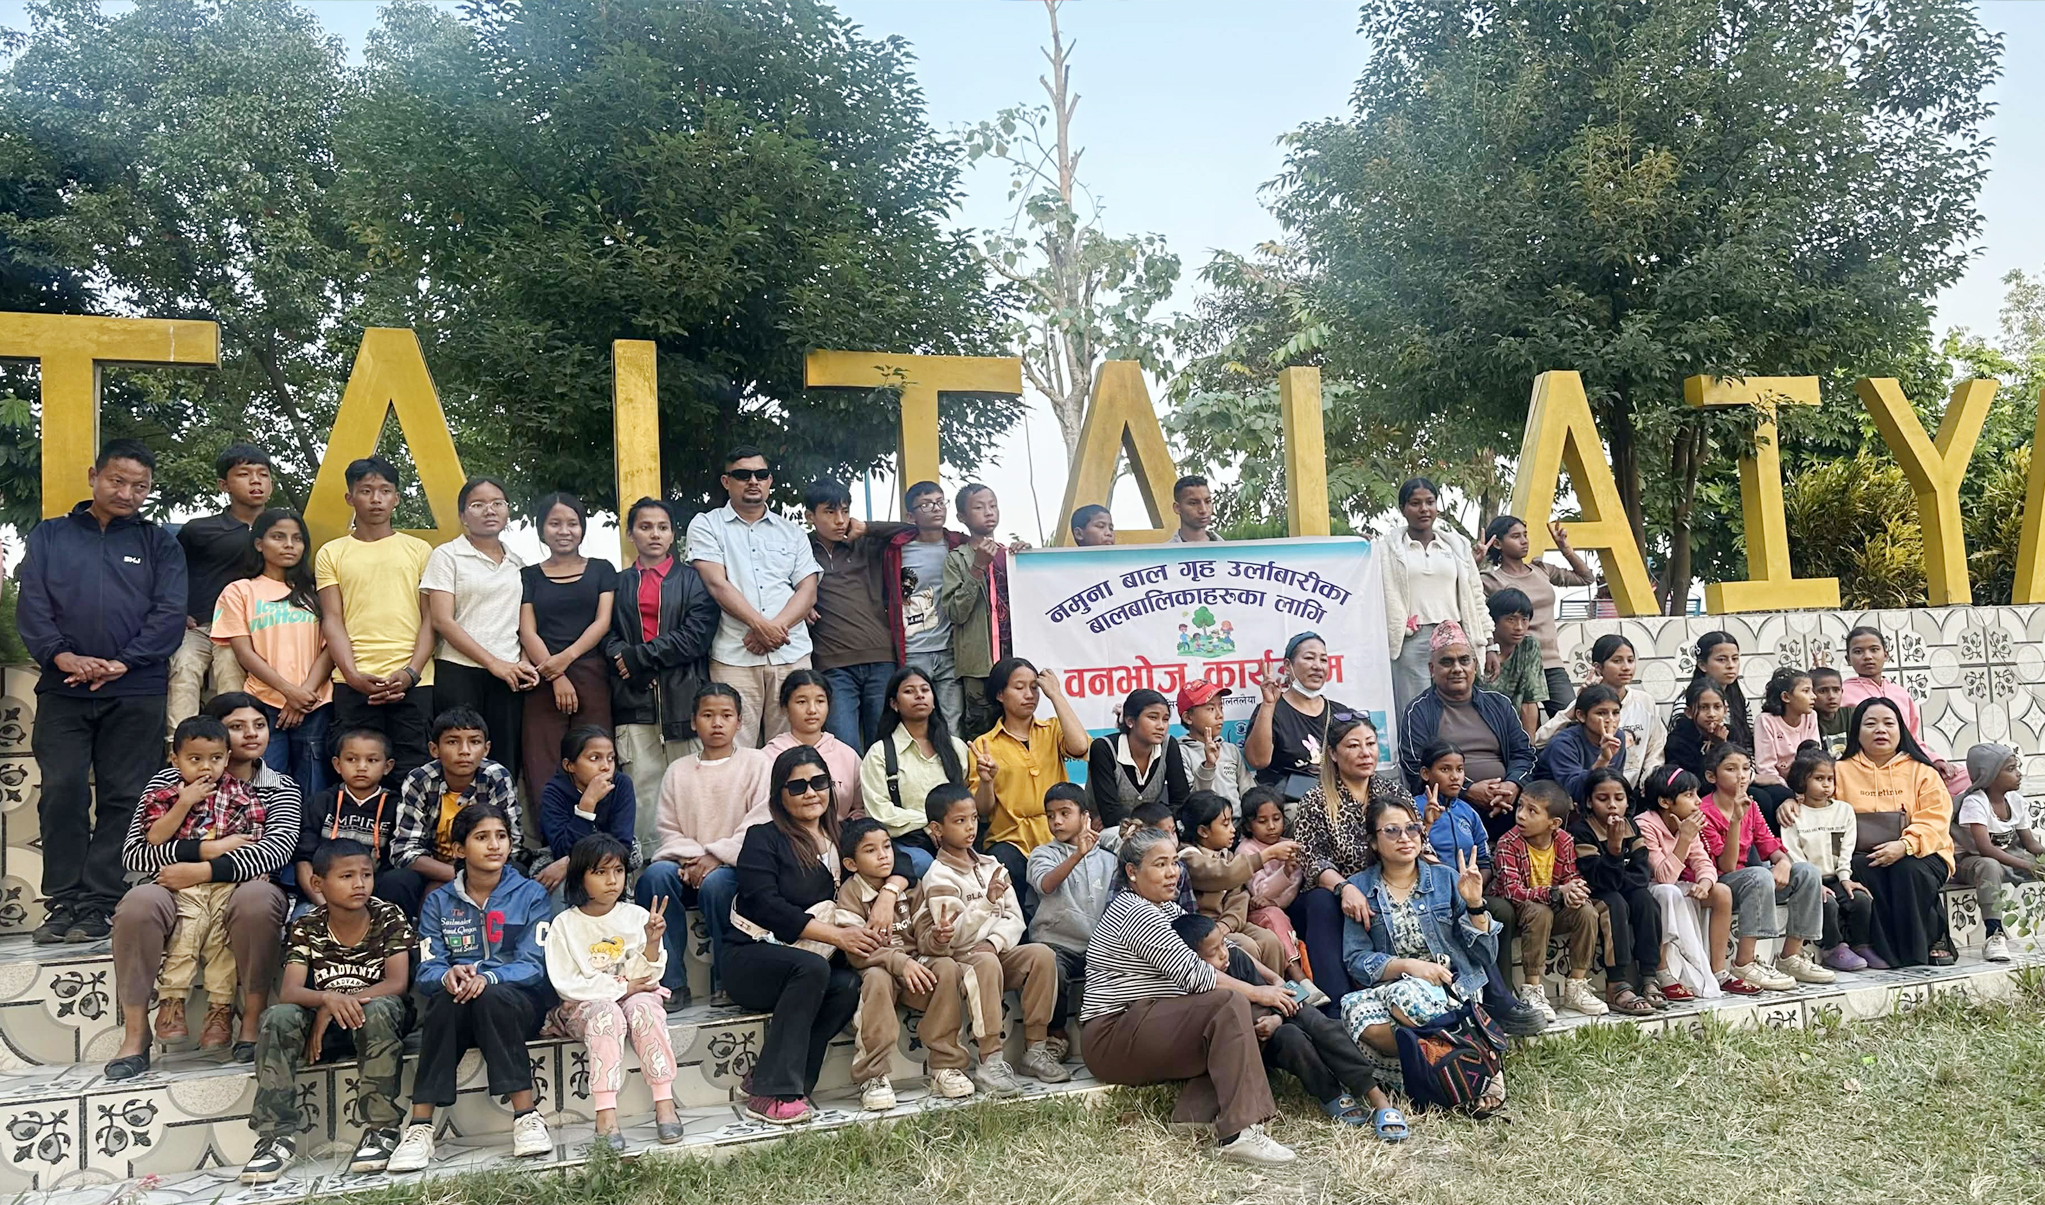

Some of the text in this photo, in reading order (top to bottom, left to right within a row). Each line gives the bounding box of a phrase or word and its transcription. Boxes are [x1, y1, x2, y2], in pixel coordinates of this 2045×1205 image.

[1045, 560, 1353, 624] नमुना बाल गृह उर्लाबारीका
[1275, 594, 1328, 624] लागि
[1064, 655, 1187, 698] वनभोज
[324, 813, 391, 832] EMPIRE
[486, 910, 505, 943] C
